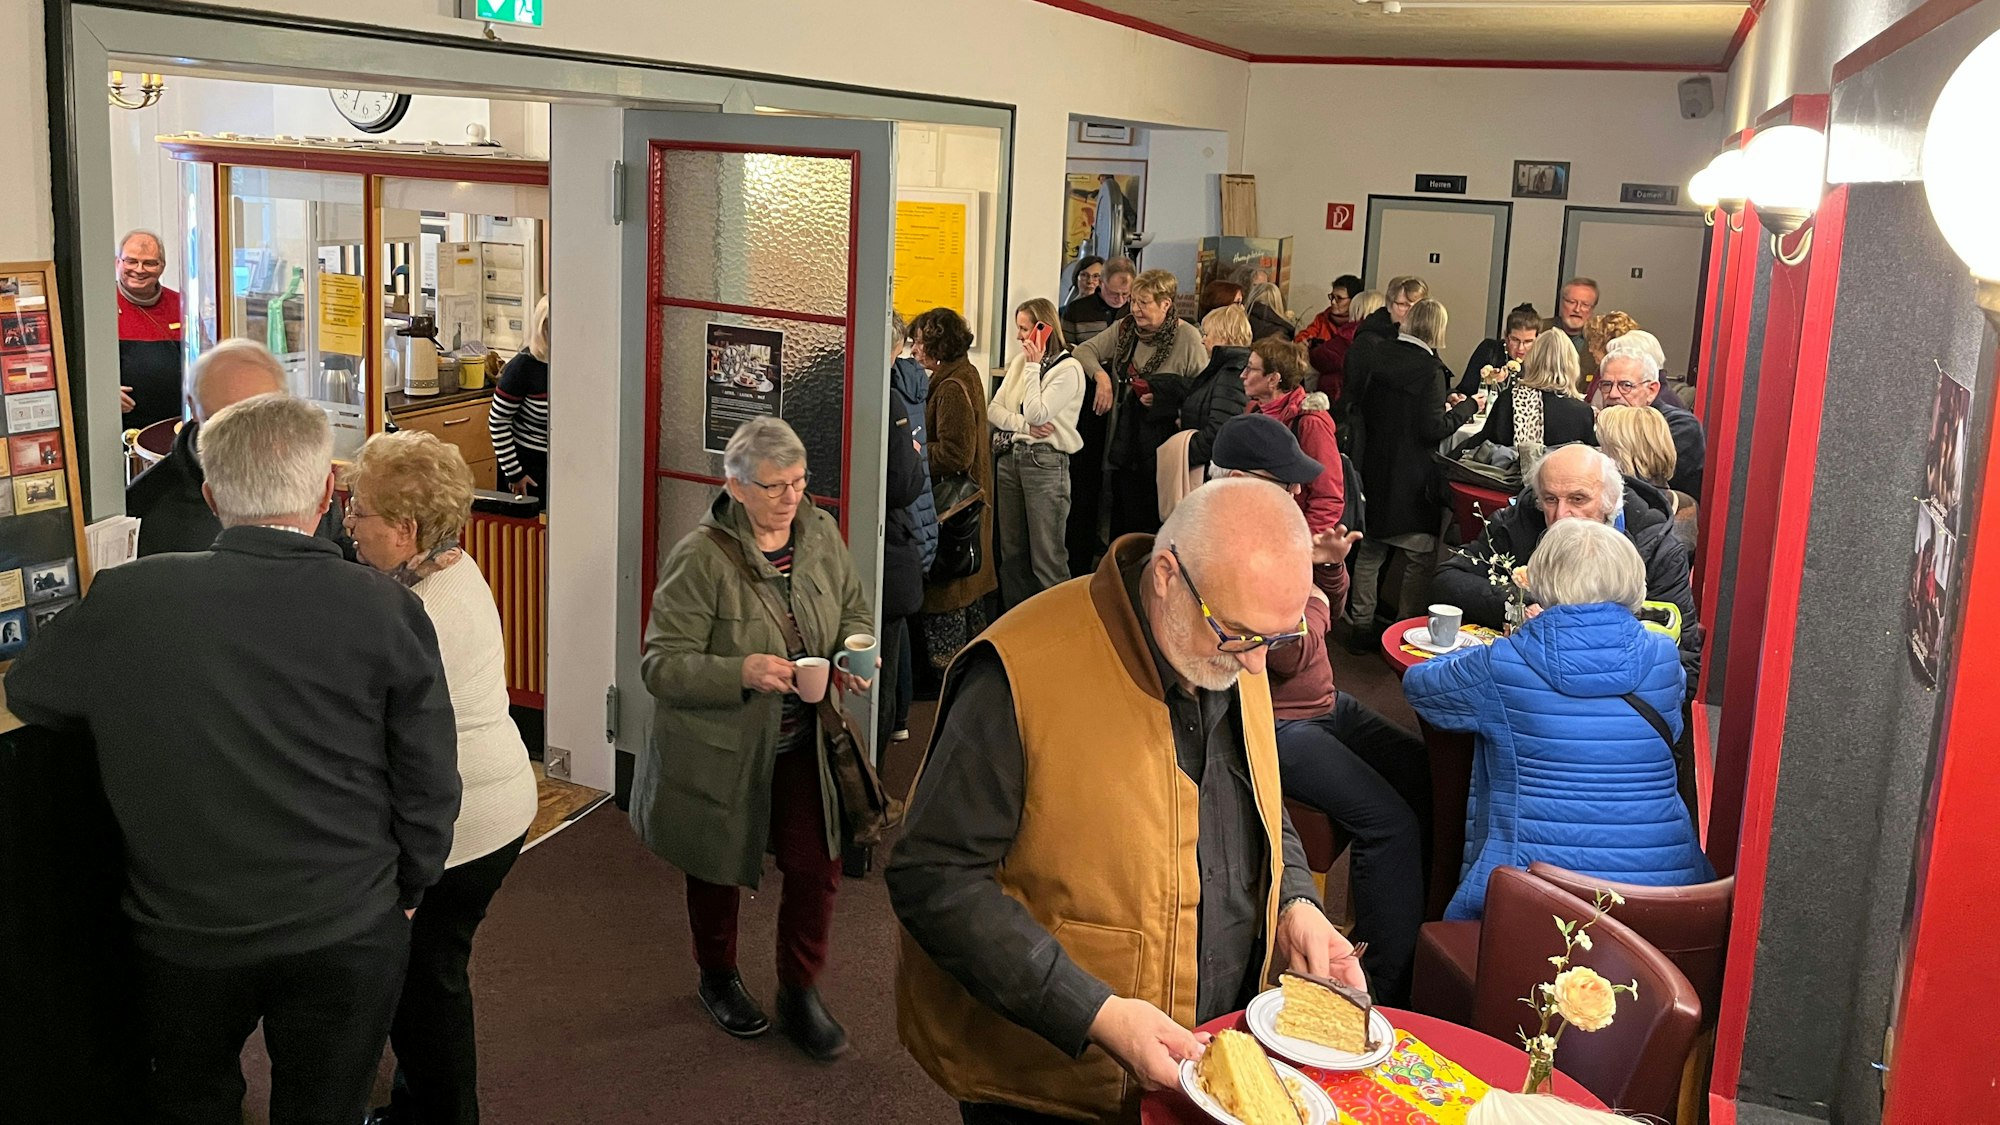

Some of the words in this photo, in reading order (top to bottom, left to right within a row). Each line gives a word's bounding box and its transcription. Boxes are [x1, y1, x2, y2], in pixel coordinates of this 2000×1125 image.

[342, 90, 348, 99] 8
[362, 104, 369, 115] 6
[374, 100, 381, 112] 5
[1429, 180, 1452, 189] Herren
[1636, 190, 1662, 199] Damen
